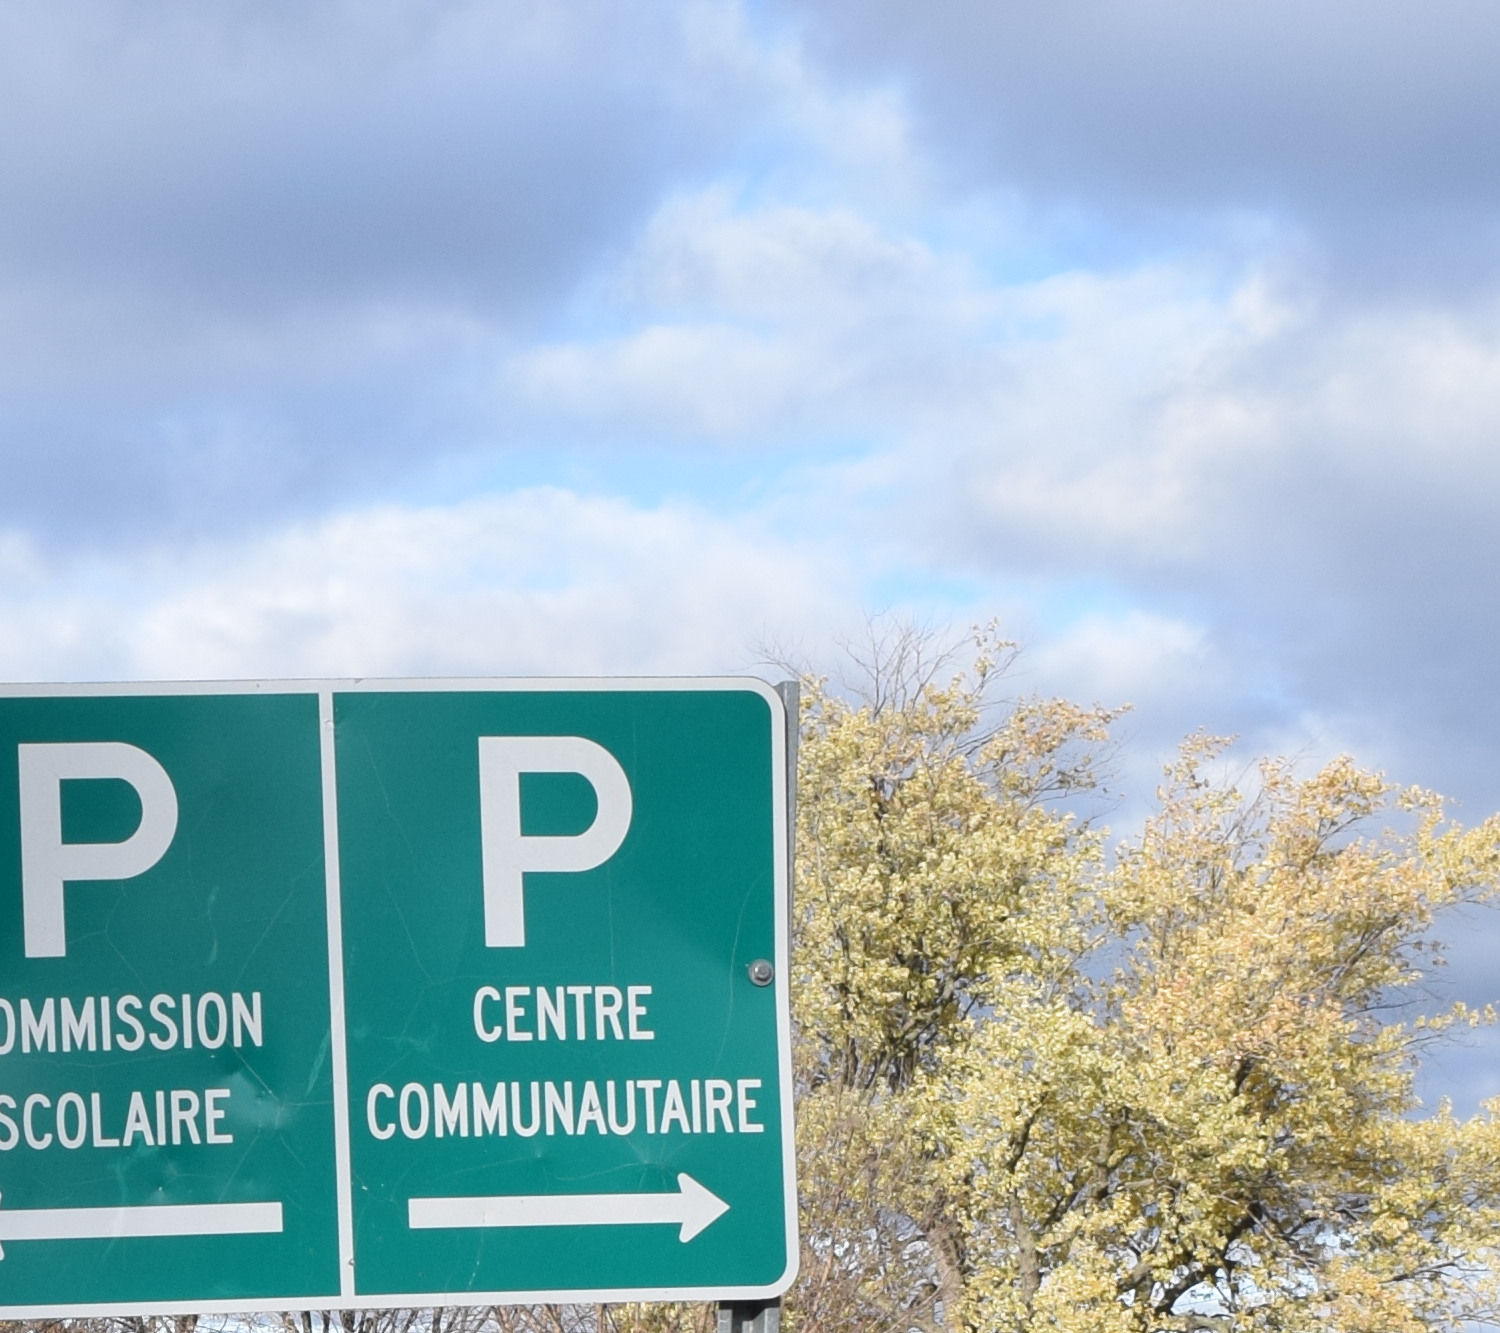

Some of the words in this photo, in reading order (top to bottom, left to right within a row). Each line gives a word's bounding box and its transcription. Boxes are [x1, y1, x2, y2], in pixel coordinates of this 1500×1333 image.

[18, 742, 178, 957] P
[479, 736, 632, 947] P
[474, 986, 654, 1042] CENTRE
[367, 1079, 764, 1139] COMMUNAUTAIRE
